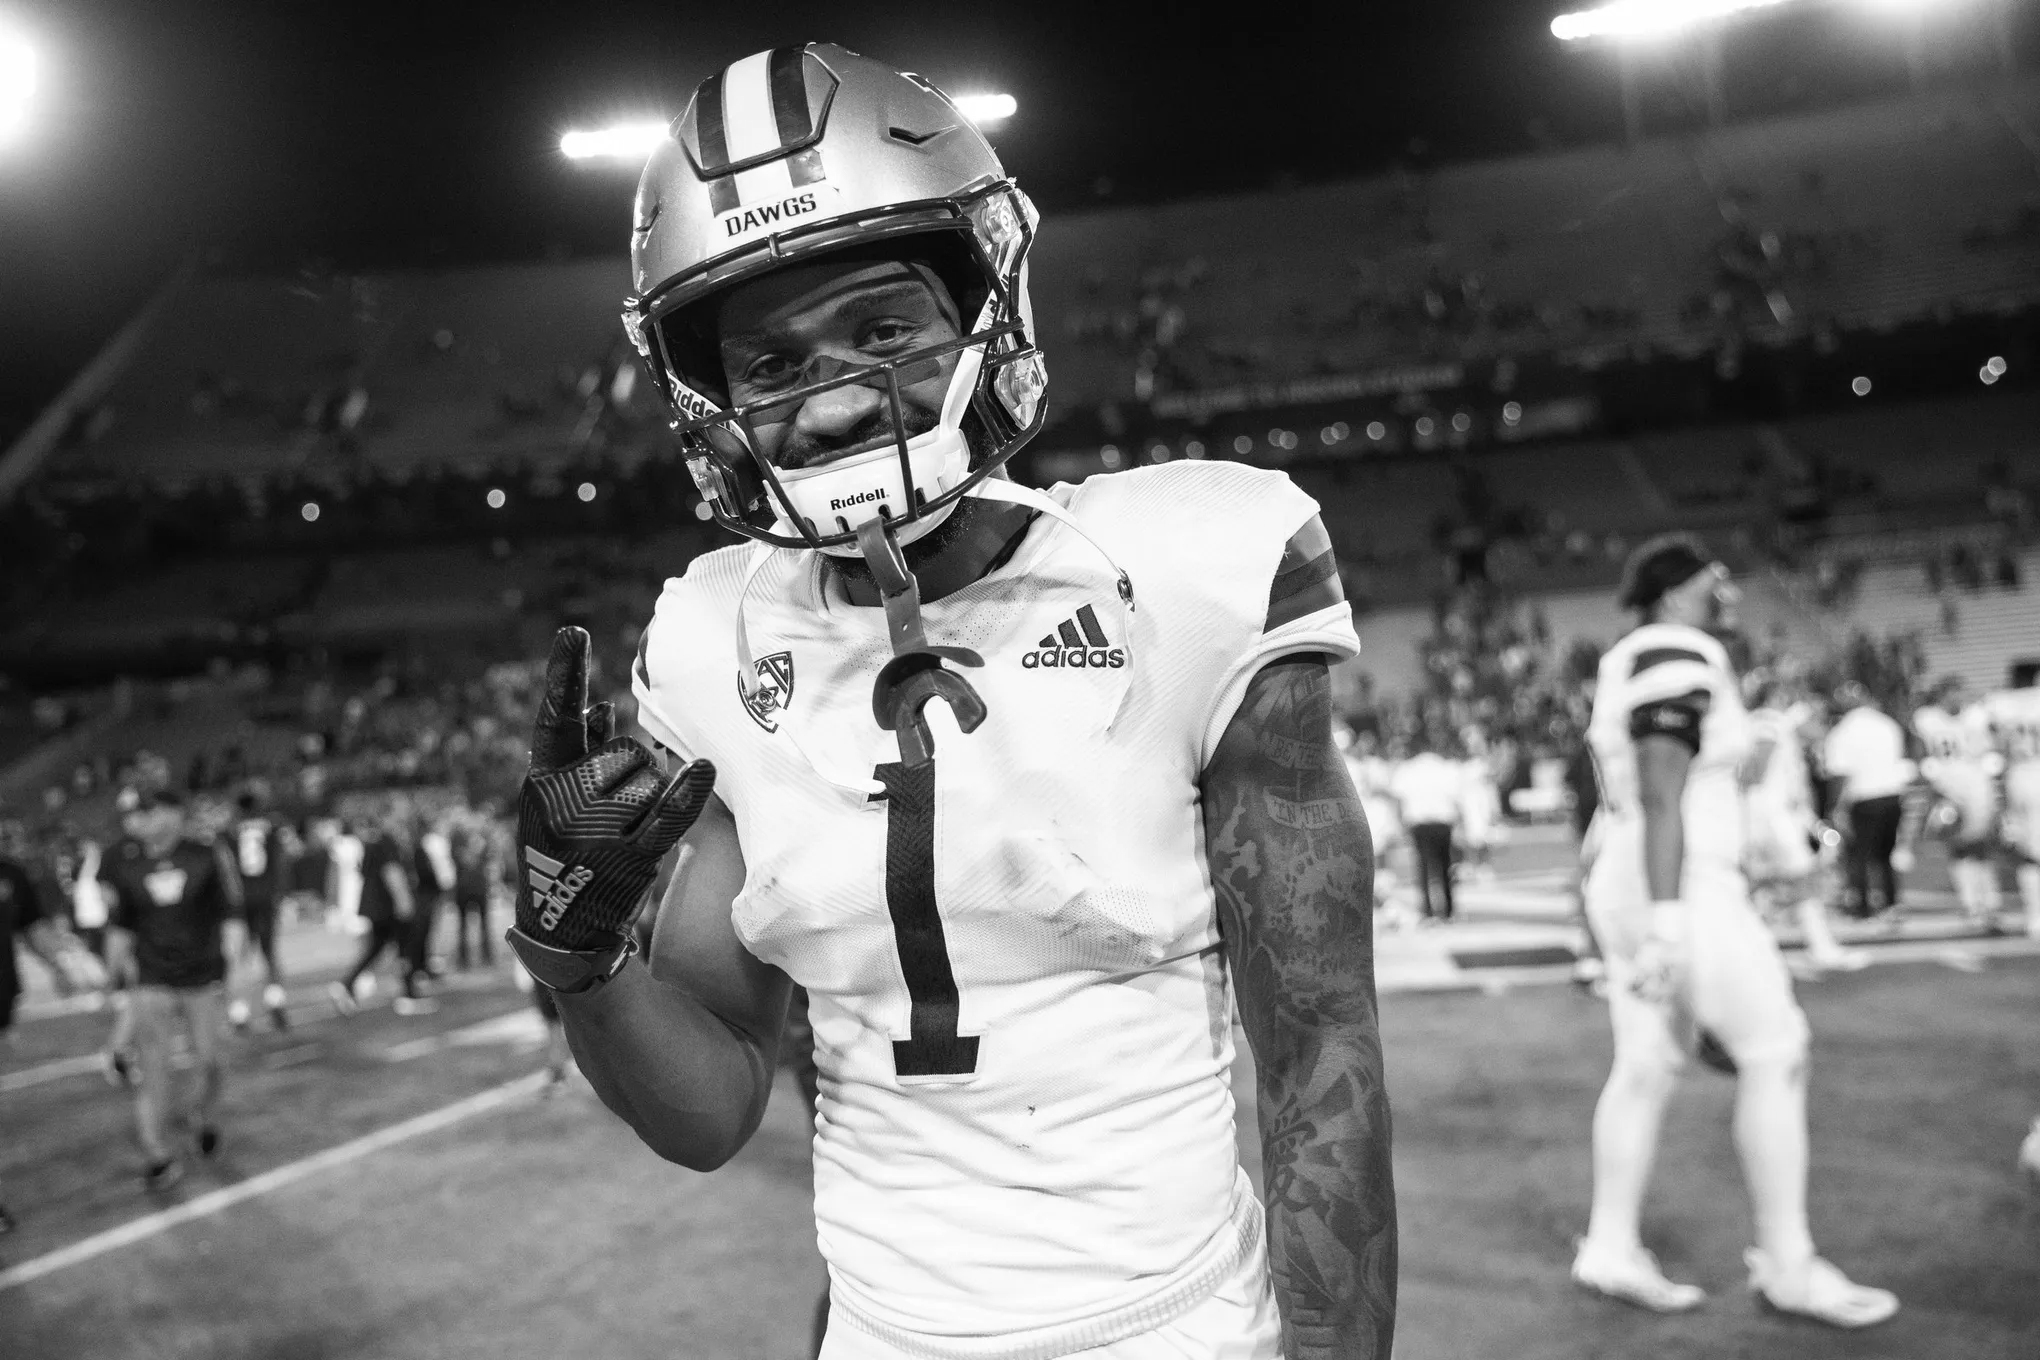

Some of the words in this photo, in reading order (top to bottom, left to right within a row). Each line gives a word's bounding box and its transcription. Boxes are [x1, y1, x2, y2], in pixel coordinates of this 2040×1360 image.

[725, 193, 817, 237] DAWGS
[830, 487, 886, 510] Riddell
[1021, 644, 1125, 669] adidas
[1300, 802, 1333, 825] THE
[540, 865, 595, 931] adidas
[867, 757, 981, 1077] 1
